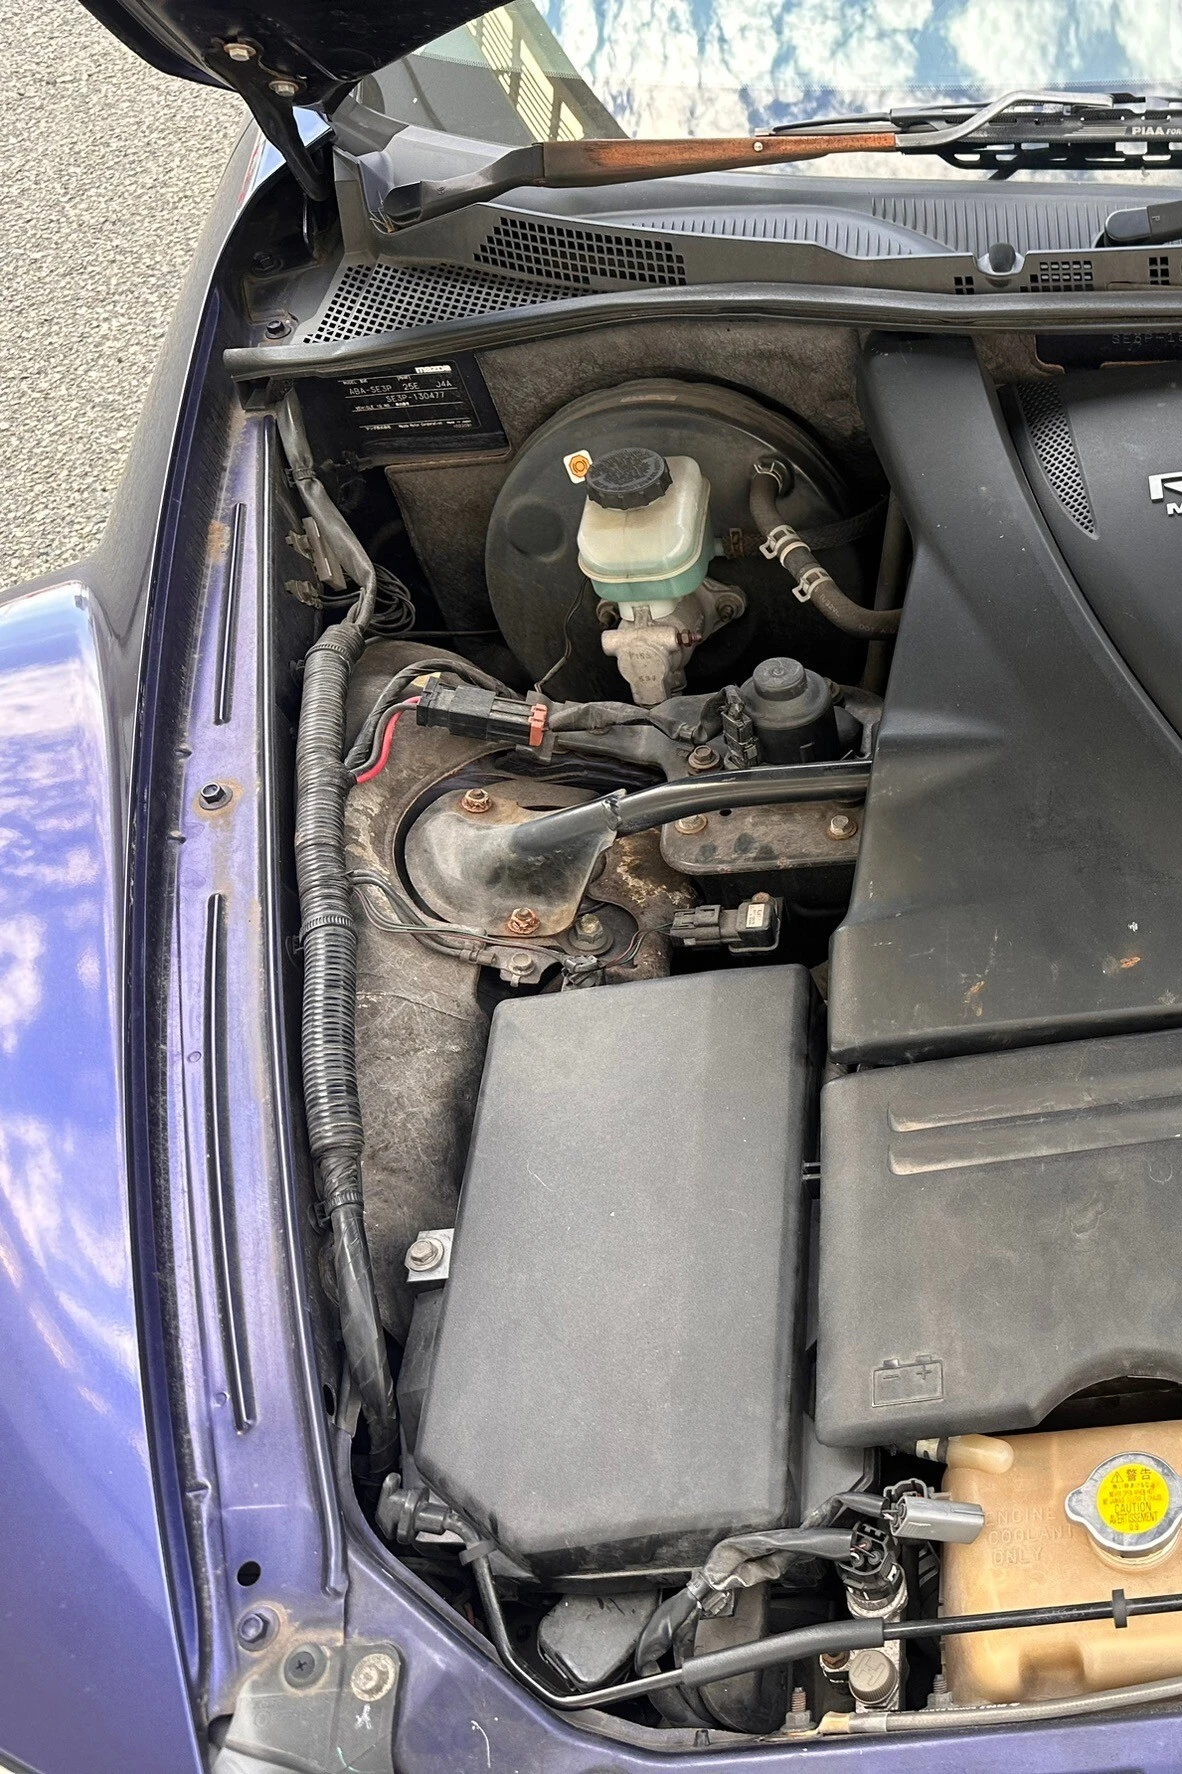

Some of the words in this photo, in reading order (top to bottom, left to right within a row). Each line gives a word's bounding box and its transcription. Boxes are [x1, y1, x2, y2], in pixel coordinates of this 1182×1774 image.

[1131, 126, 1164, 135] PIAA
[349, 385, 392, 395] ABA-SE3P
[402, 382, 420, 391] 25E
[436, 380, 452, 388] J4A
[385, 391, 445, 403] SE3P-130477
[1126, 1468, 1152, 1481] 警告
[1115, 1501, 1152, 1515] CAUTION
[986, 1506, 1056, 1527] ENGINE
[1110, 1510, 1158, 1525] AVERTISSEMENT
[988, 1524, 1074, 1545] COOLANT
[993, 1546, 1044, 1566] ONLY
